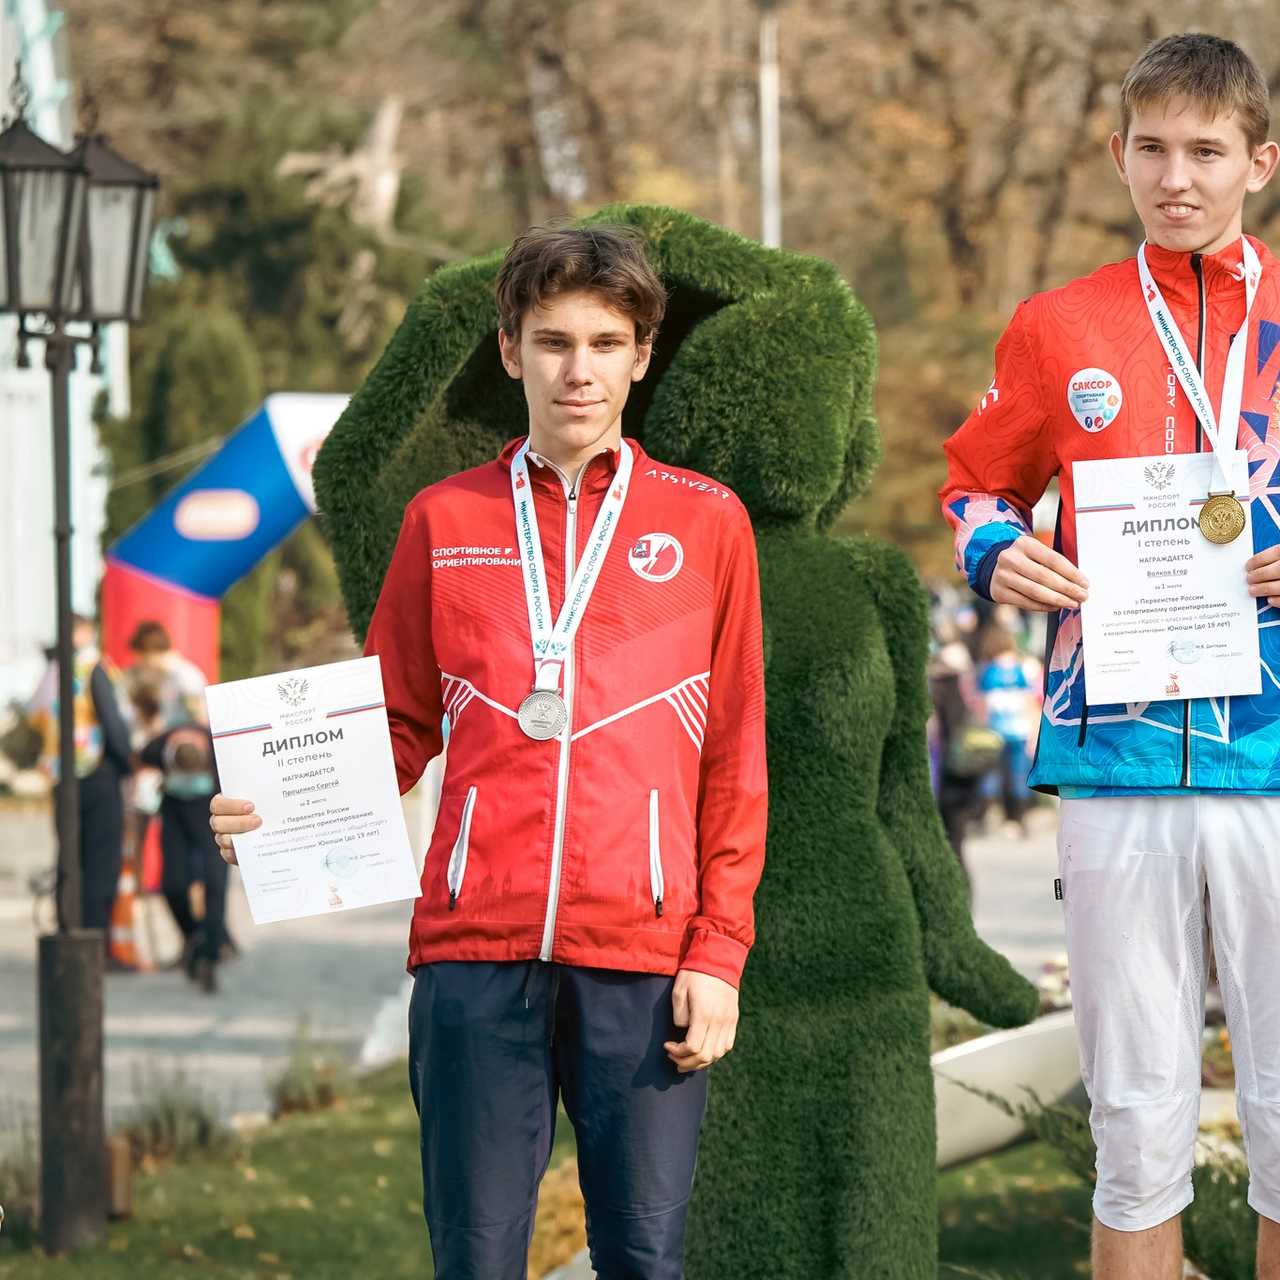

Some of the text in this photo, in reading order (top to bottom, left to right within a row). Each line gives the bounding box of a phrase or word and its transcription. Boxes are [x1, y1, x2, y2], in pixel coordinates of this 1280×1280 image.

[1156, 311, 1212, 429] МИНИСТЕРСТВО СПОРТА РОССИИ
[1072, 381, 1112, 391] САКСОР
[1145, 538, 1190, 547] степень
[432, 547, 501, 557] СПОРТИВНОЕ
[1139, 554, 1193, 563] НАГРАЖДАЕТСЯ
[432, 557, 522, 569] ОРИЕНТИРОВАНИ
[520, 501, 544, 629] МИНИСТЕРСТВО СПОРТА РОССИИ
[562, 511, 614, 633] МИНИСТЕРСТВО СПОРТА РОССИИ
[1140, 597, 1178, 605] Первенстве
[1169, 603, 1227, 612] ориентированию
[285, 717, 313, 726] РОССИИ
[261, 728, 344, 757] ДИПЛОМ
[287, 752, 332, 765] степень
[282, 767, 335, 782] НАГРАЖДАЕТСЯ
[282, 779, 339, 797] Проценко Сергей
[287, 811, 325, 823] Первенстве
[327, 807, 350, 815] России
[272, 823, 315, 836] спортивному
[316, 811, 373, 827] ориентированию
[318, 837, 343, 846] Юноши
[366, 829, 379, 837] лет)
